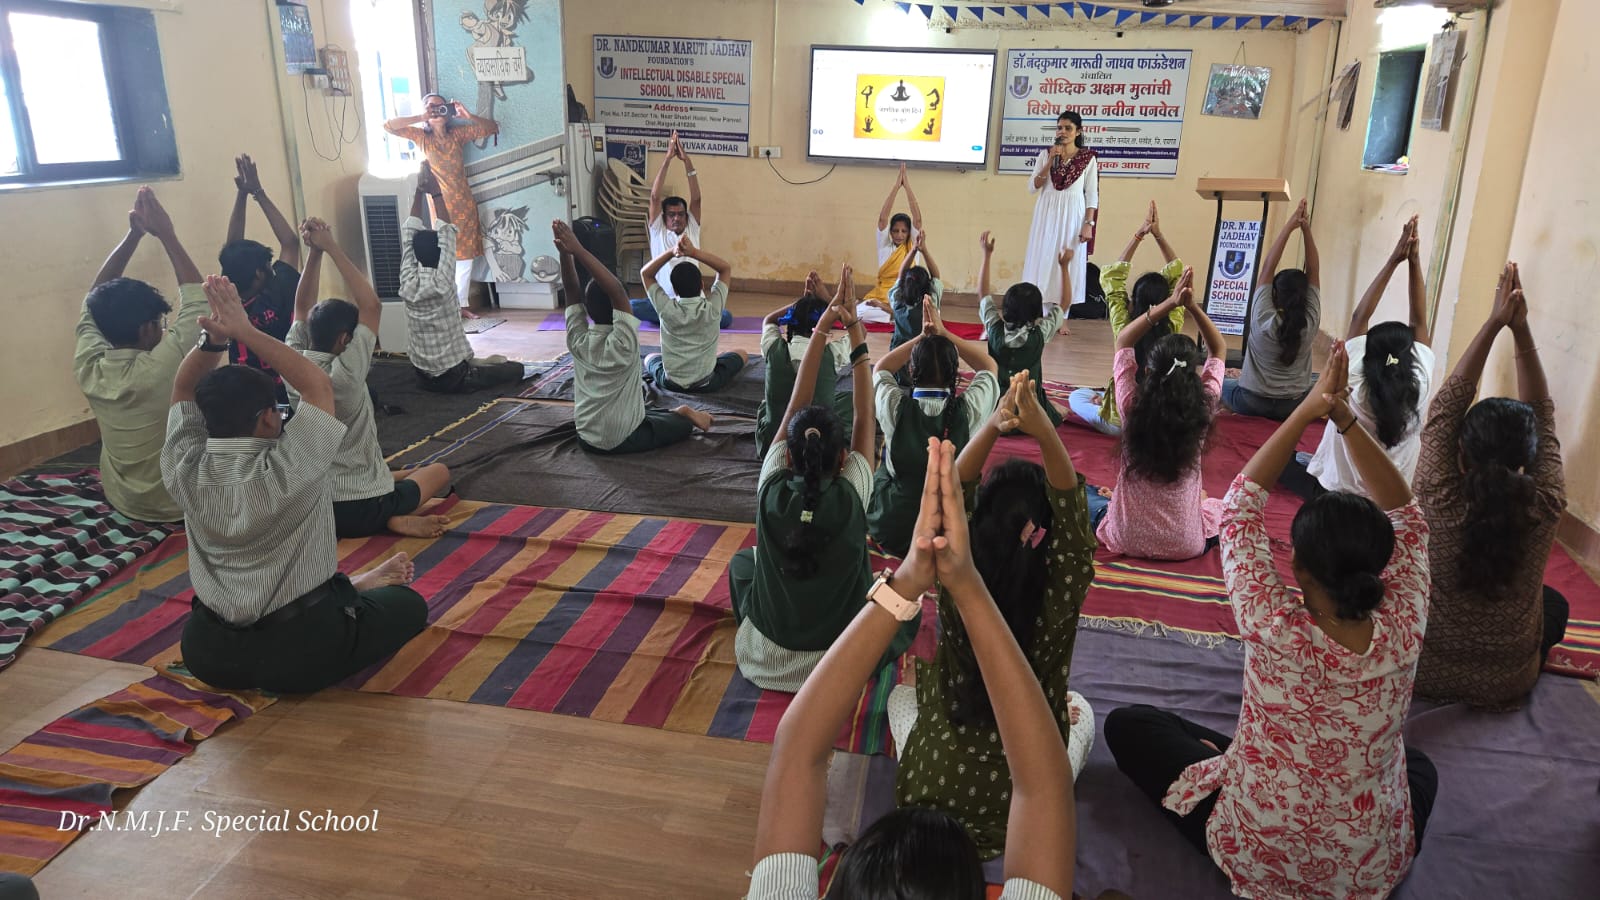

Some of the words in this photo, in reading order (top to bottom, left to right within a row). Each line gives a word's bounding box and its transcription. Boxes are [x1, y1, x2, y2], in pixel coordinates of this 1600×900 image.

[596, 38, 611, 51] DR.
[614, 39, 670, 54] NANDKUMAR
[673, 41, 708, 56] MARUTI
[710, 43, 747, 57] JADHAV
[1105, 57, 1134, 70] जाधव
[1137, 53, 1186, 70] फाऊंडेशन
[620, 67, 675, 82] INTELLECTUAL
[676, 70, 711, 84] DISABLE
[712, 71, 746, 86] SPECIAL
[1080, 71, 1112, 80] संचालित
[640, 83, 674, 98] SCHOOL,
[676, 85, 694, 99] NEW
[695, 86, 726, 100] PANVEL
[1089, 83, 1126, 95] अक्षम
[1129, 79, 1172, 100] मुलांची
[653, 103, 689, 113] Address
[1027, 99, 1062, 116] विशेष
[1101, 100, 1136, 117] नवीन
[1139, 101, 1180, 117] पनवेल
[707, 143, 739, 153] AADHAR
[1121, 161, 1151, 170] आधार
[1221, 221, 1237, 231] DR.
[1238, 222, 1247, 231] N.
[1248, 222, 1259, 232] M.
[1221, 232, 1257, 241] JADHAV
[1212, 280, 1249, 291] SPECIAL
[1211, 291, 1247, 302] SCHOOL
